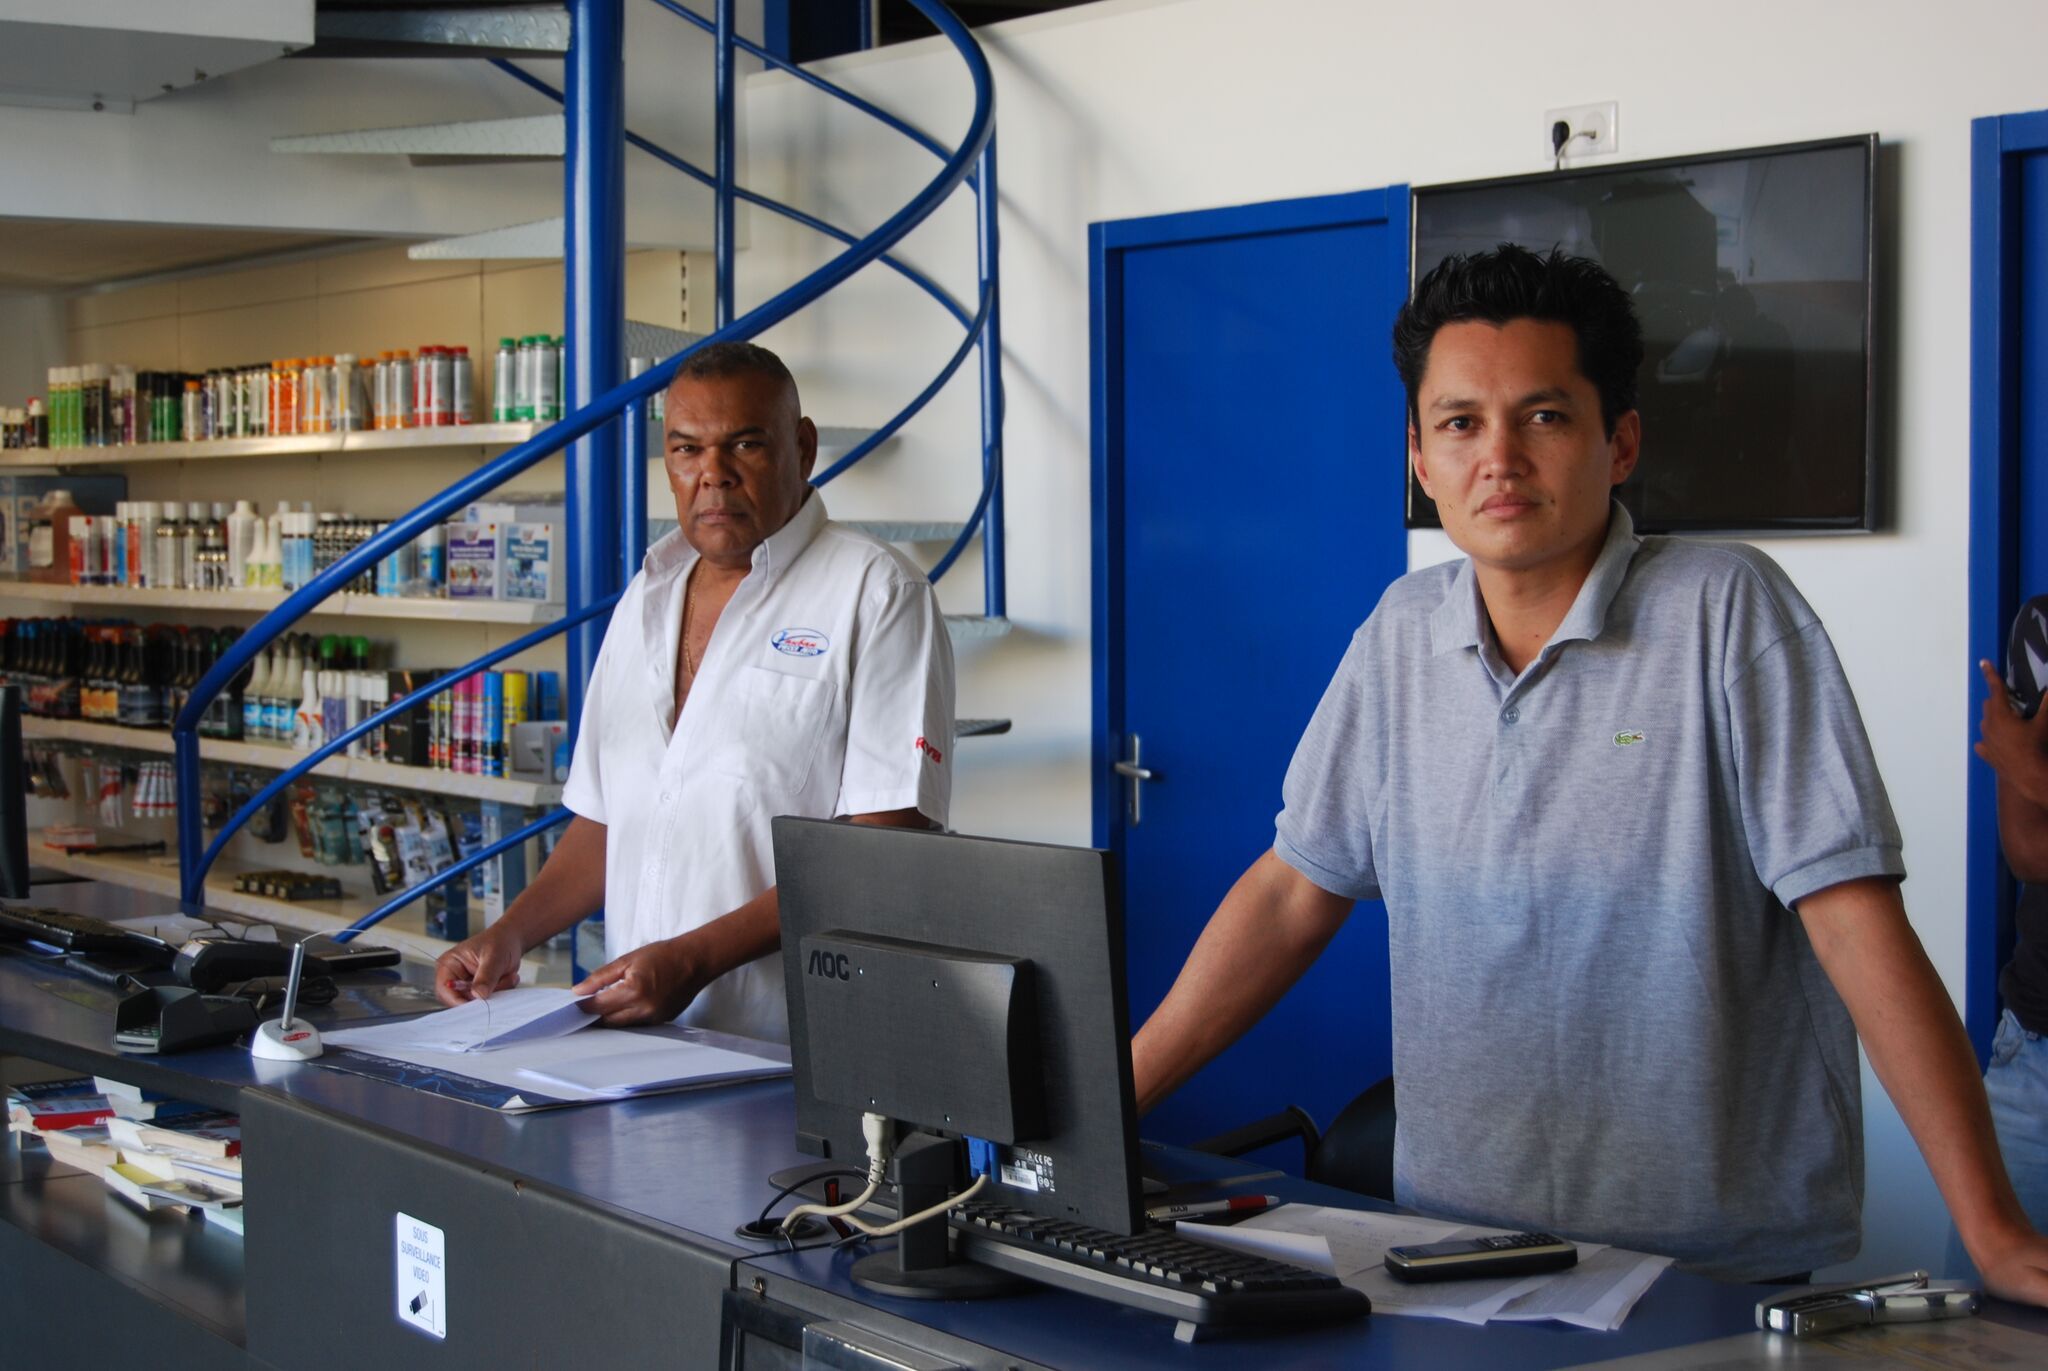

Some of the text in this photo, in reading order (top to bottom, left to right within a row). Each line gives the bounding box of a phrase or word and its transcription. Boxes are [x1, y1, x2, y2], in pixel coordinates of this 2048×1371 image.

[808, 949, 850, 981] AOC
[412, 1226, 429, 1244] SOUS
[400, 1240, 441, 1269] SURVEILLANCE
[412, 1264, 430, 1284] VIDEO
